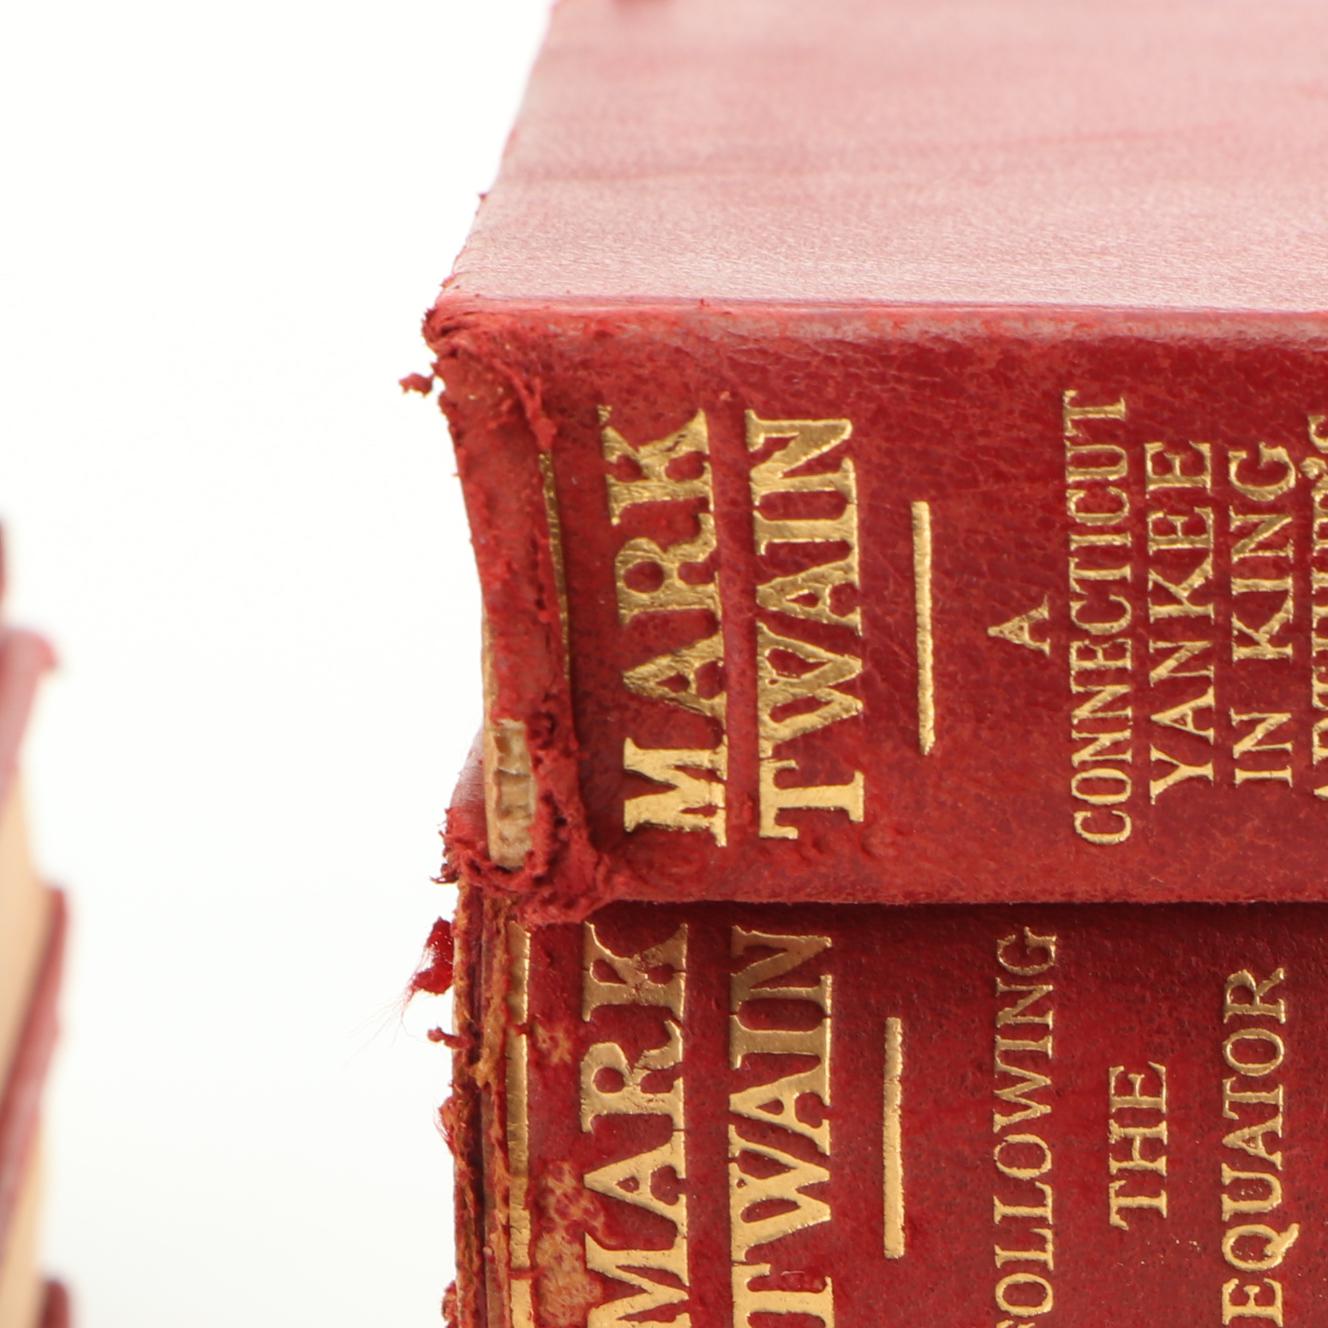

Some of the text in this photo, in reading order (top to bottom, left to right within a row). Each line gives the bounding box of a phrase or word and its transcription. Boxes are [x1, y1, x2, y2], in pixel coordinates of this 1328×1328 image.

[598, 406, 729, 846] MARK
[746, 408, 865, 839] TWAIN
[987, 604, 1051, 653] A
[1063, 389, 1134, 844] CONNECTICUT
[1144, 441, 1216, 803] YANKEE
[1228, 443, 1297, 784] IN KING
[1108, 1063, 1169, 1229] THE
[1220, 968, 1301, 1328] EQUATOR
